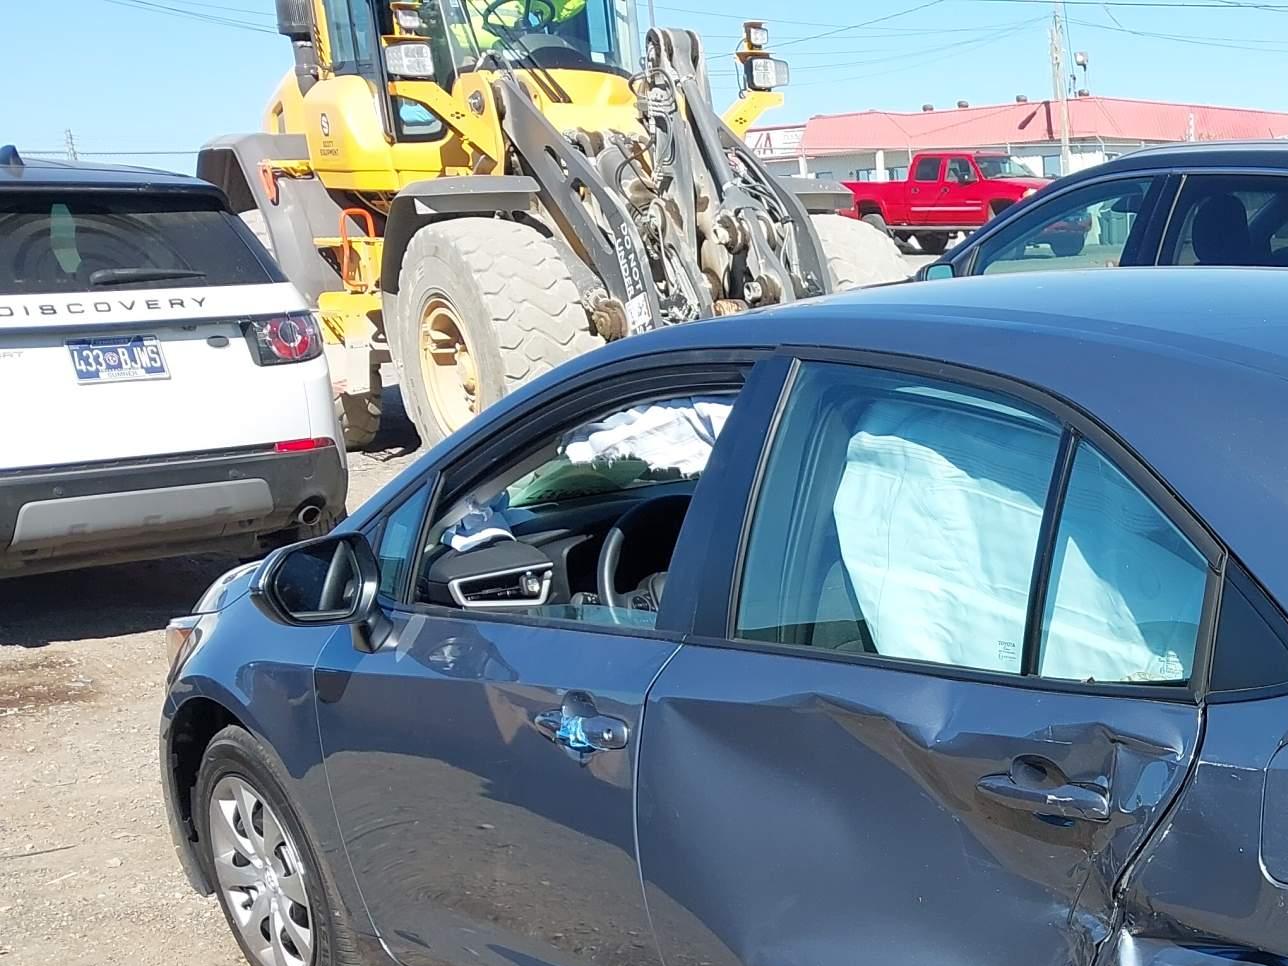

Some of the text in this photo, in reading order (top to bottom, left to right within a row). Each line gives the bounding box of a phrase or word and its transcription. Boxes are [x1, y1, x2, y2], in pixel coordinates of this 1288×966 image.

[620, 222, 643, 291] DO NOT
[0, 297, 206, 316] DISCOVERY
[73, 349, 106, 372] 433
